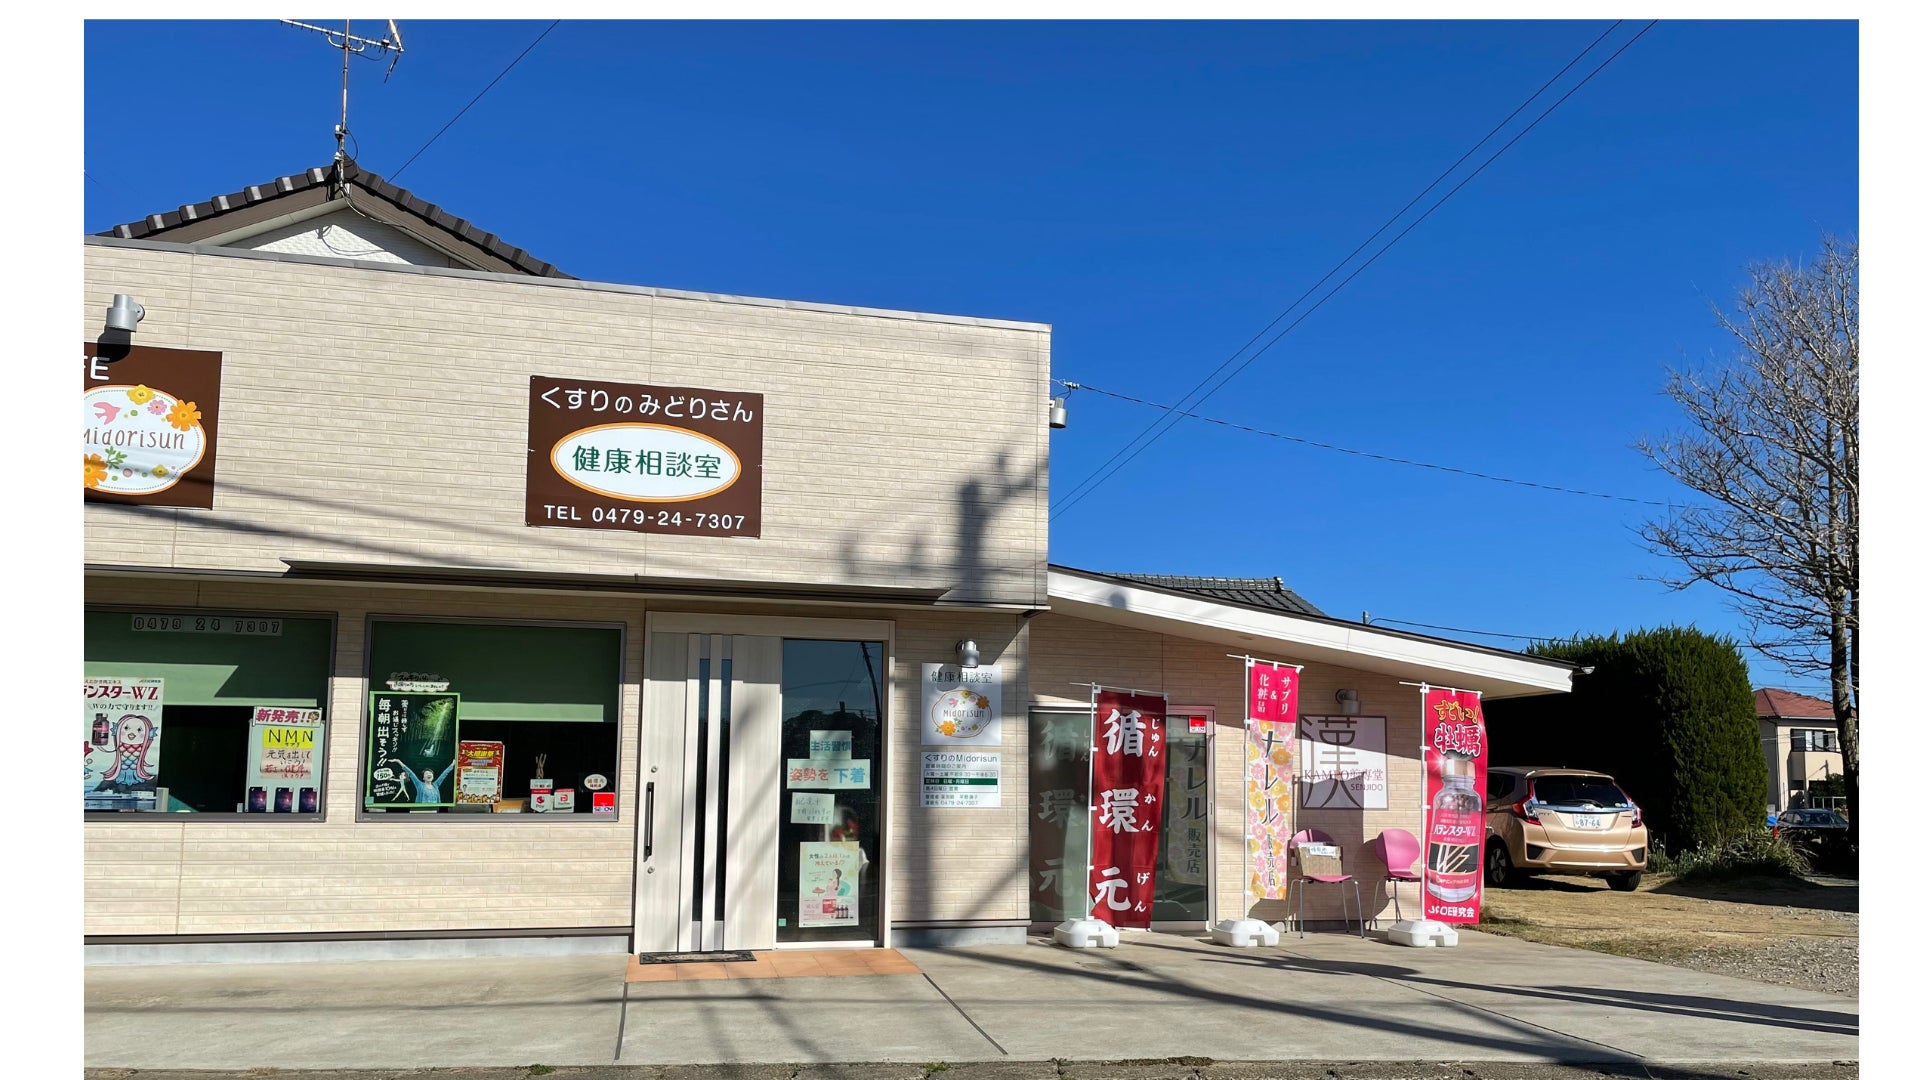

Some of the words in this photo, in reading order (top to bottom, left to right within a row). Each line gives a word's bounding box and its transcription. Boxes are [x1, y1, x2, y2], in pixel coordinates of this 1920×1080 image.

[84, 355, 110, 380] E
[541, 386, 753, 422] くすりのみどりさん
[572, 445, 721, 478] 健康相談室
[544, 504, 582, 520] TEL
[592, 507, 745, 530] 0479-24-7307
[196, 618, 221, 631] 24
[932, 670, 992, 684] 健康相談室
[1256, 674, 1270, 713] 化粧品
[1270, 690, 1278, 700] &
[1280, 676, 1292, 714] サプリ
[944, 710, 984, 718] Midorisun
[1434, 700, 1480, 724] すごい!
[268, 730, 313, 743] NMN
[1148, 718, 1160, 758] じゅん
[1434, 722, 1482, 757] 牡蠣
[924, 754, 998, 762] くすりのMidorisun
[790, 768, 828, 782] 姿勢を
[834, 767, 866, 784] 下着
[1262, 730, 1283, 824] ナレル
[1096, 708, 1147, 911] 循環元
[1141, 793, 1156, 832] かん
[1188, 828, 1202, 874] 販売店
[1134, 872, 1150, 912] げん
